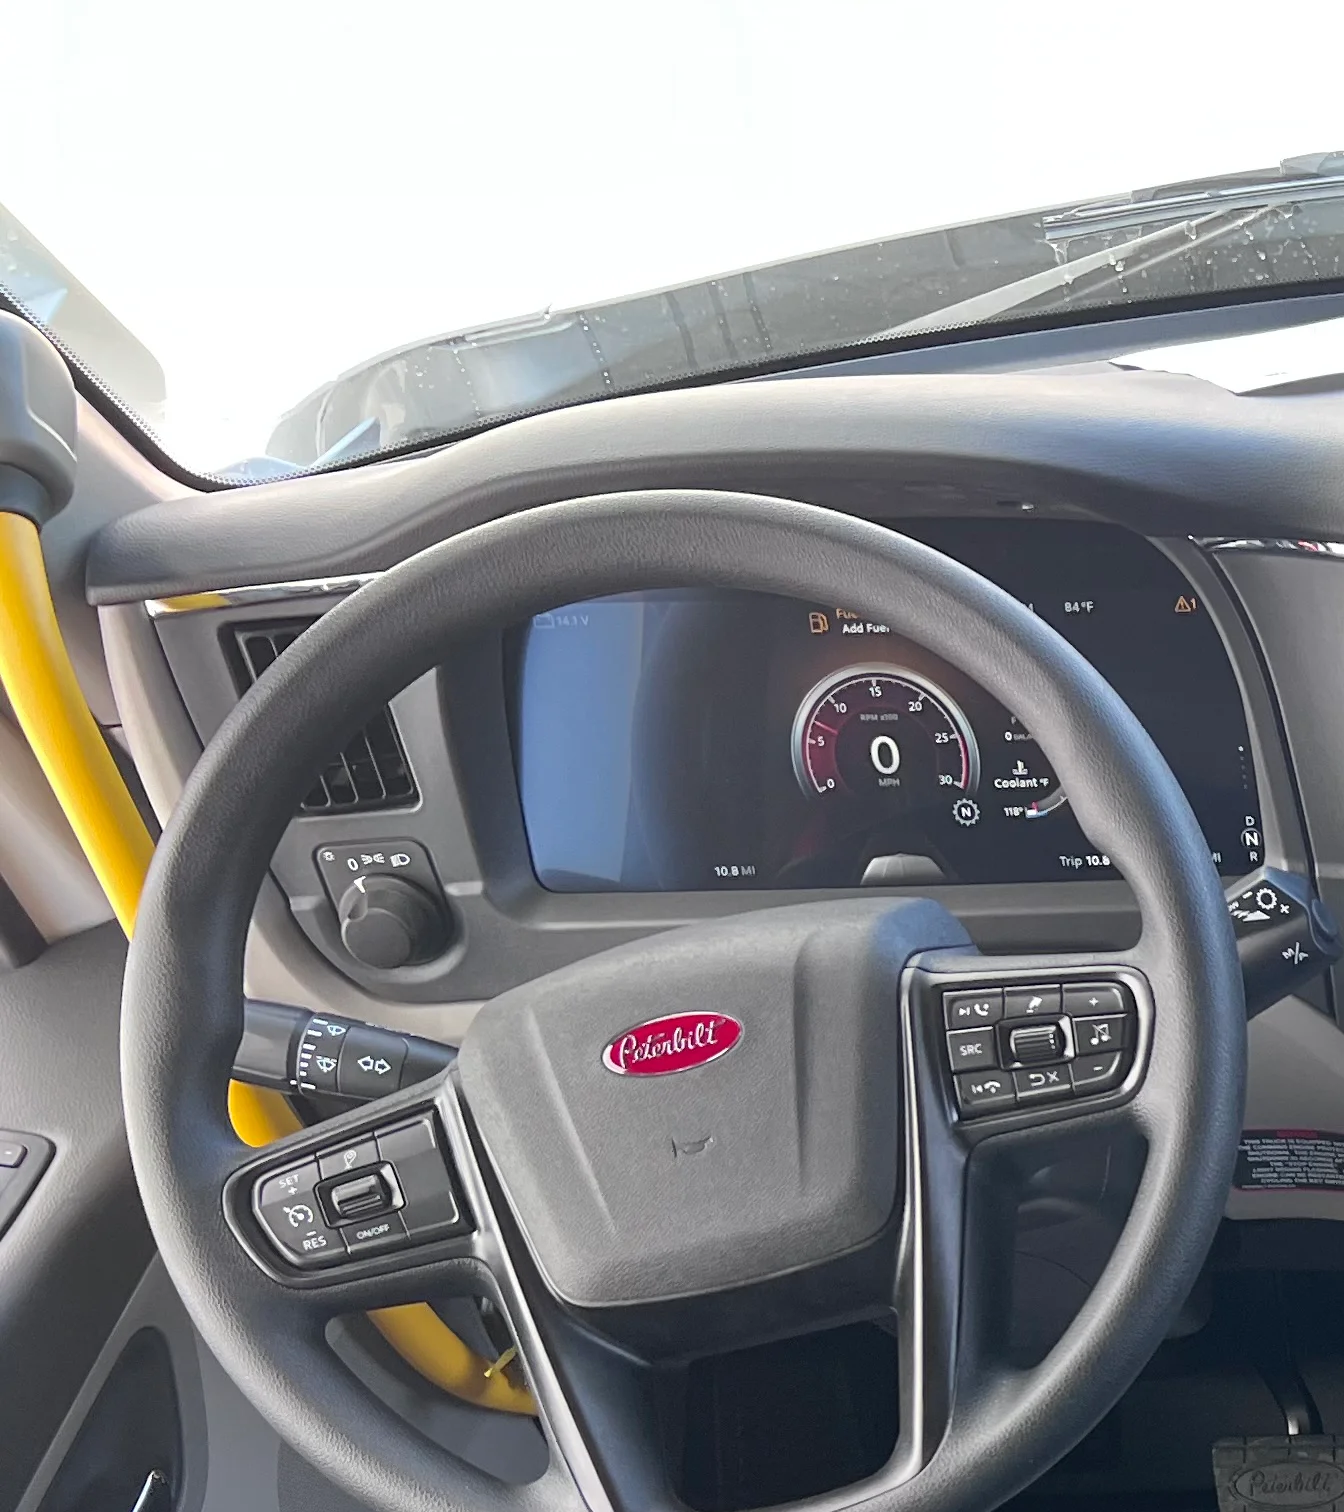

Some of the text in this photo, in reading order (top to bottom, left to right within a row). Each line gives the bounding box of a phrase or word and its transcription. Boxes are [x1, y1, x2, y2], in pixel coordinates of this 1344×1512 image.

[842, 623, 864, 634] Add
[869, 686, 882, 697] 15
[833, 702, 847, 713] 10
[908, 701, 922, 712] 20
[817, 737, 825, 747] 5
[935, 732, 949, 744] 25
[870, 735, 900, 775] 0
[826, 778, 835, 789] 0
[878, 778, 900, 788] MPH
[939, 775, 953, 786] 30
[994, 777, 1038, 789] Coolant
[960, 807, 972, 817] N
[1245, 816, 1255, 826] D
[1244, 832, 1259, 846] N
[1059, 854, 1082, 869] Trip
[1249, 852, 1259, 862] R
[714, 866, 755, 877] 10.8 MI
[620, 1019, 726, 1069] Peterbilt
[960, 1043, 982, 1056] SRC
[278, 1174, 299, 1189] SET
[356, 1224, 389, 1240] ON/OFF
[303, 1236, 327, 1251] RES
